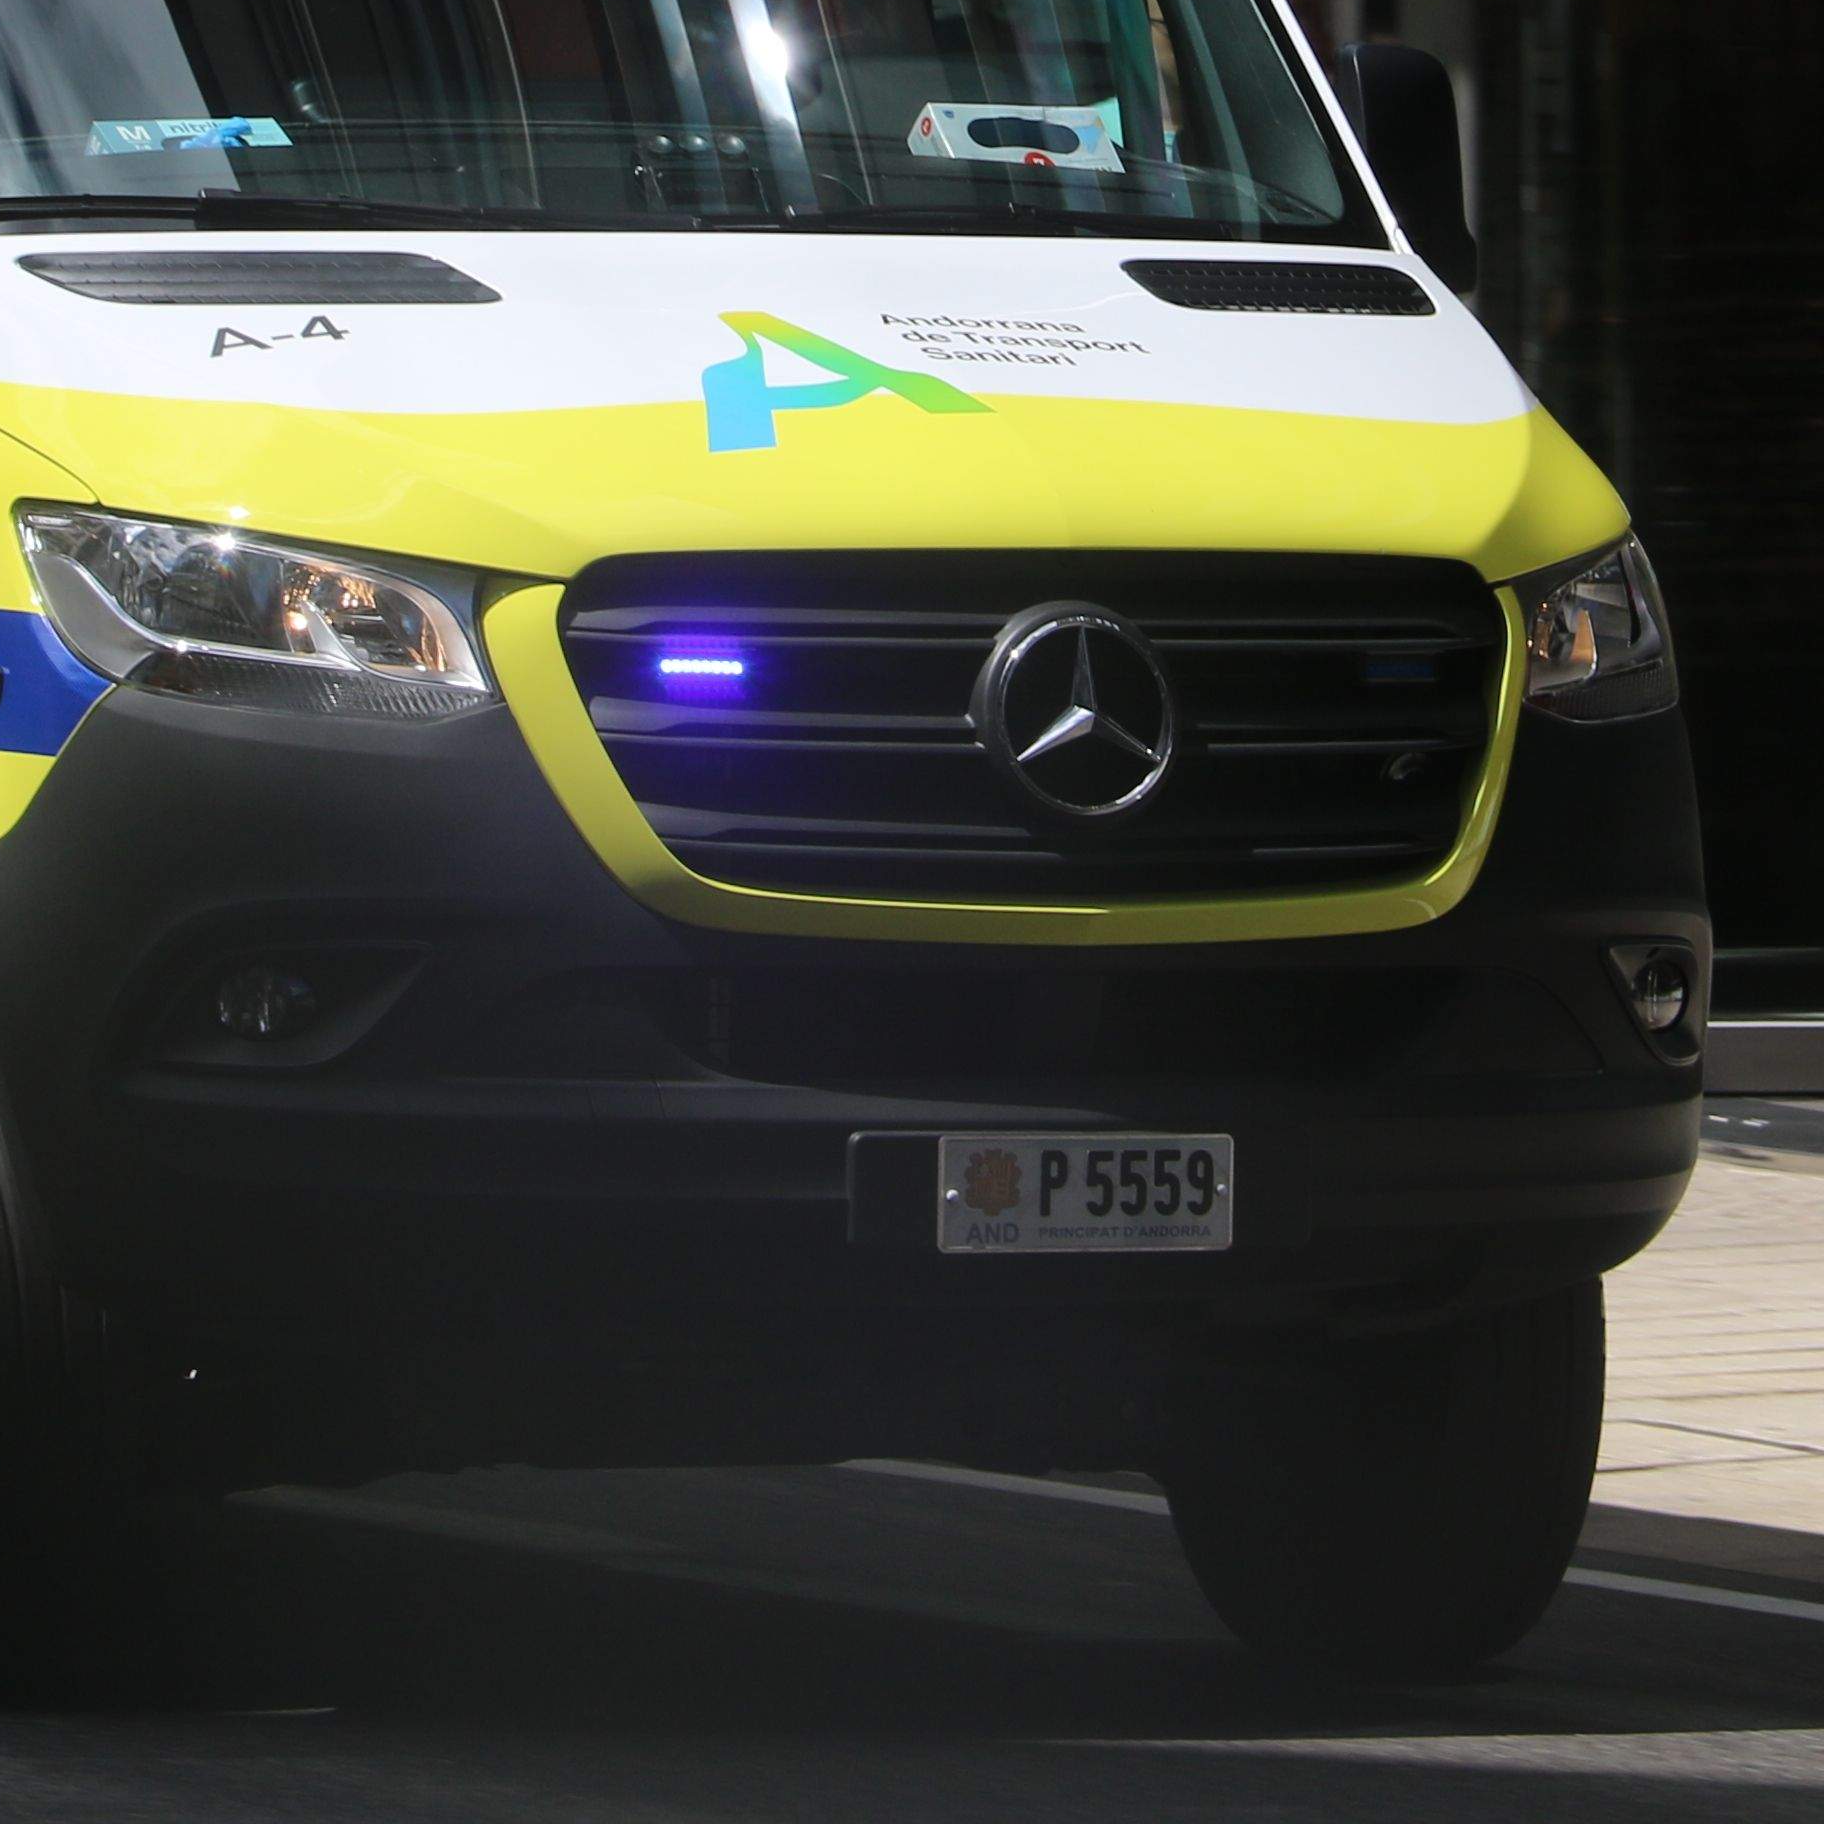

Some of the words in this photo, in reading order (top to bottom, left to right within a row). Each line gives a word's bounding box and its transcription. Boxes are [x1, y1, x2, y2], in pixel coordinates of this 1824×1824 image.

[116, 125, 152, 141] M
[169, 120, 223, 135] nitril
[881, 314, 1085, 333] Andorrana
[210, 315, 351, 357] A-4
[901, 331, 951, 344] de
[953, 331, 1150, 354] Transport
[921, 346, 1078, 366] Sanitari
[1040, 1150, 1068, 1217] P
[1085, 1149, 1214, 1217] 5559
[966, 1223, 1021, 1245] AND
[1038, 1227, 1118, 1239] PRINCIPAT
[1123, 1226, 1213, 1239] D'ANDORRA
